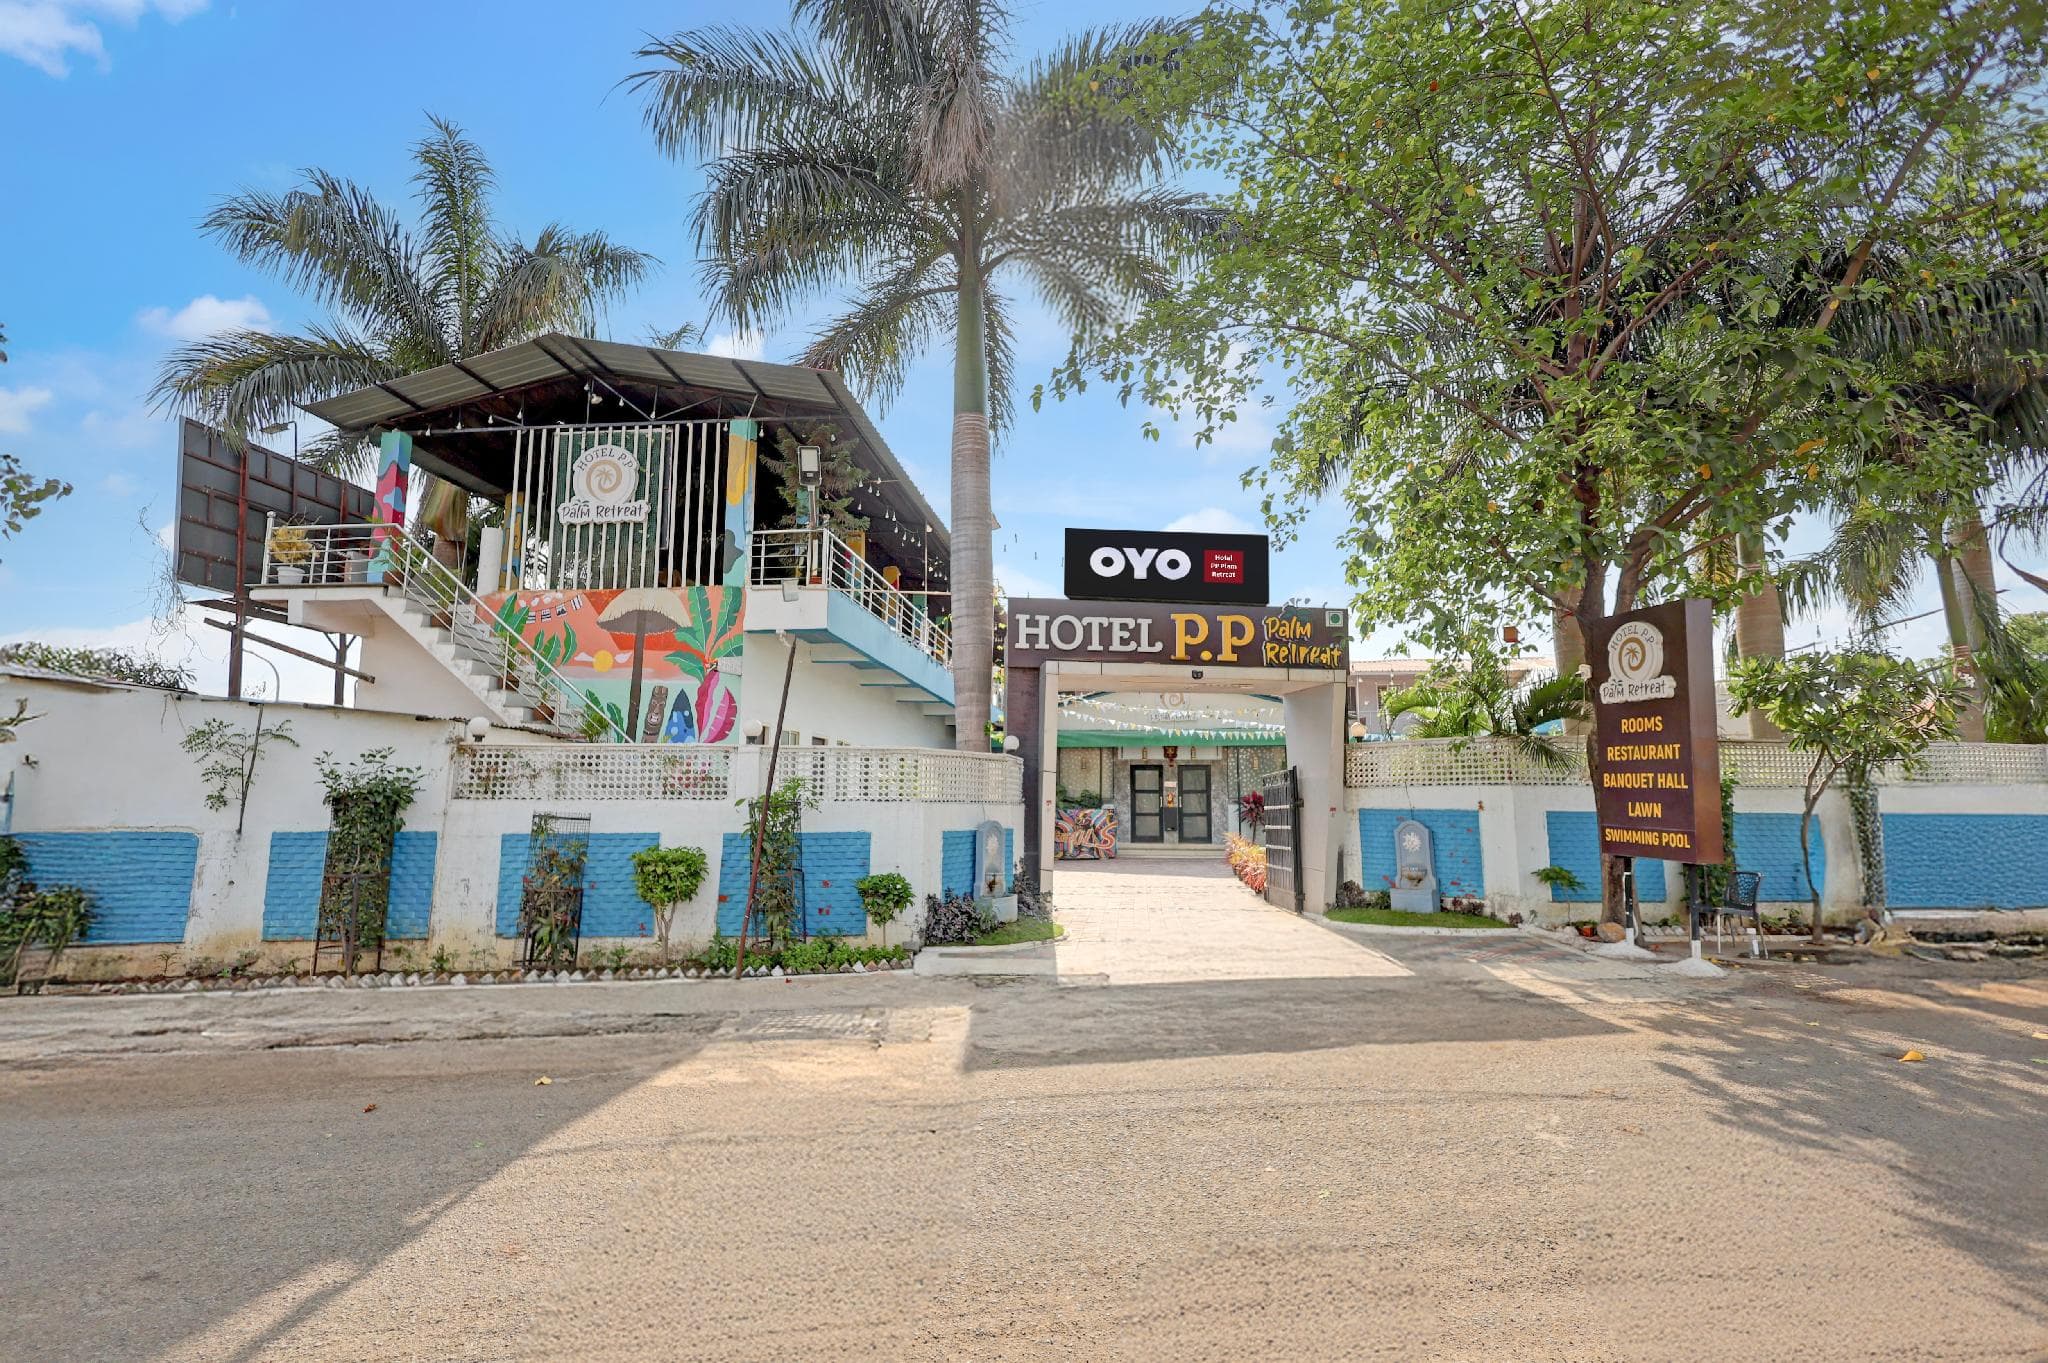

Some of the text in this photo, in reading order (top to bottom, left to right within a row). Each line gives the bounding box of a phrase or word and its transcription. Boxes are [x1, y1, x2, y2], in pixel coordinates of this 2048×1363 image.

[577, 447, 615, 471] HOTEL
[562, 504, 643, 519] Palm Retreat
[1089, 546, 1192, 580] OYO
[1014, 613, 1255, 662] HOTEL P.P
[1264, 616, 1313, 639] Palm
[1610, 624, 1639, 651] HOTEL
[1264, 642, 1342, 667] Retreat
[1628, 680, 1665, 697] Retreat
[1621, 716, 1663, 734] ROOMS
[1607, 744, 1681, 761] RESTAURANT
[1603, 773, 1689, 789] BANQUET HALL
[1628, 801, 1662, 818] LAWN
[1605, 828, 1691, 848] SWIMMING POOL
